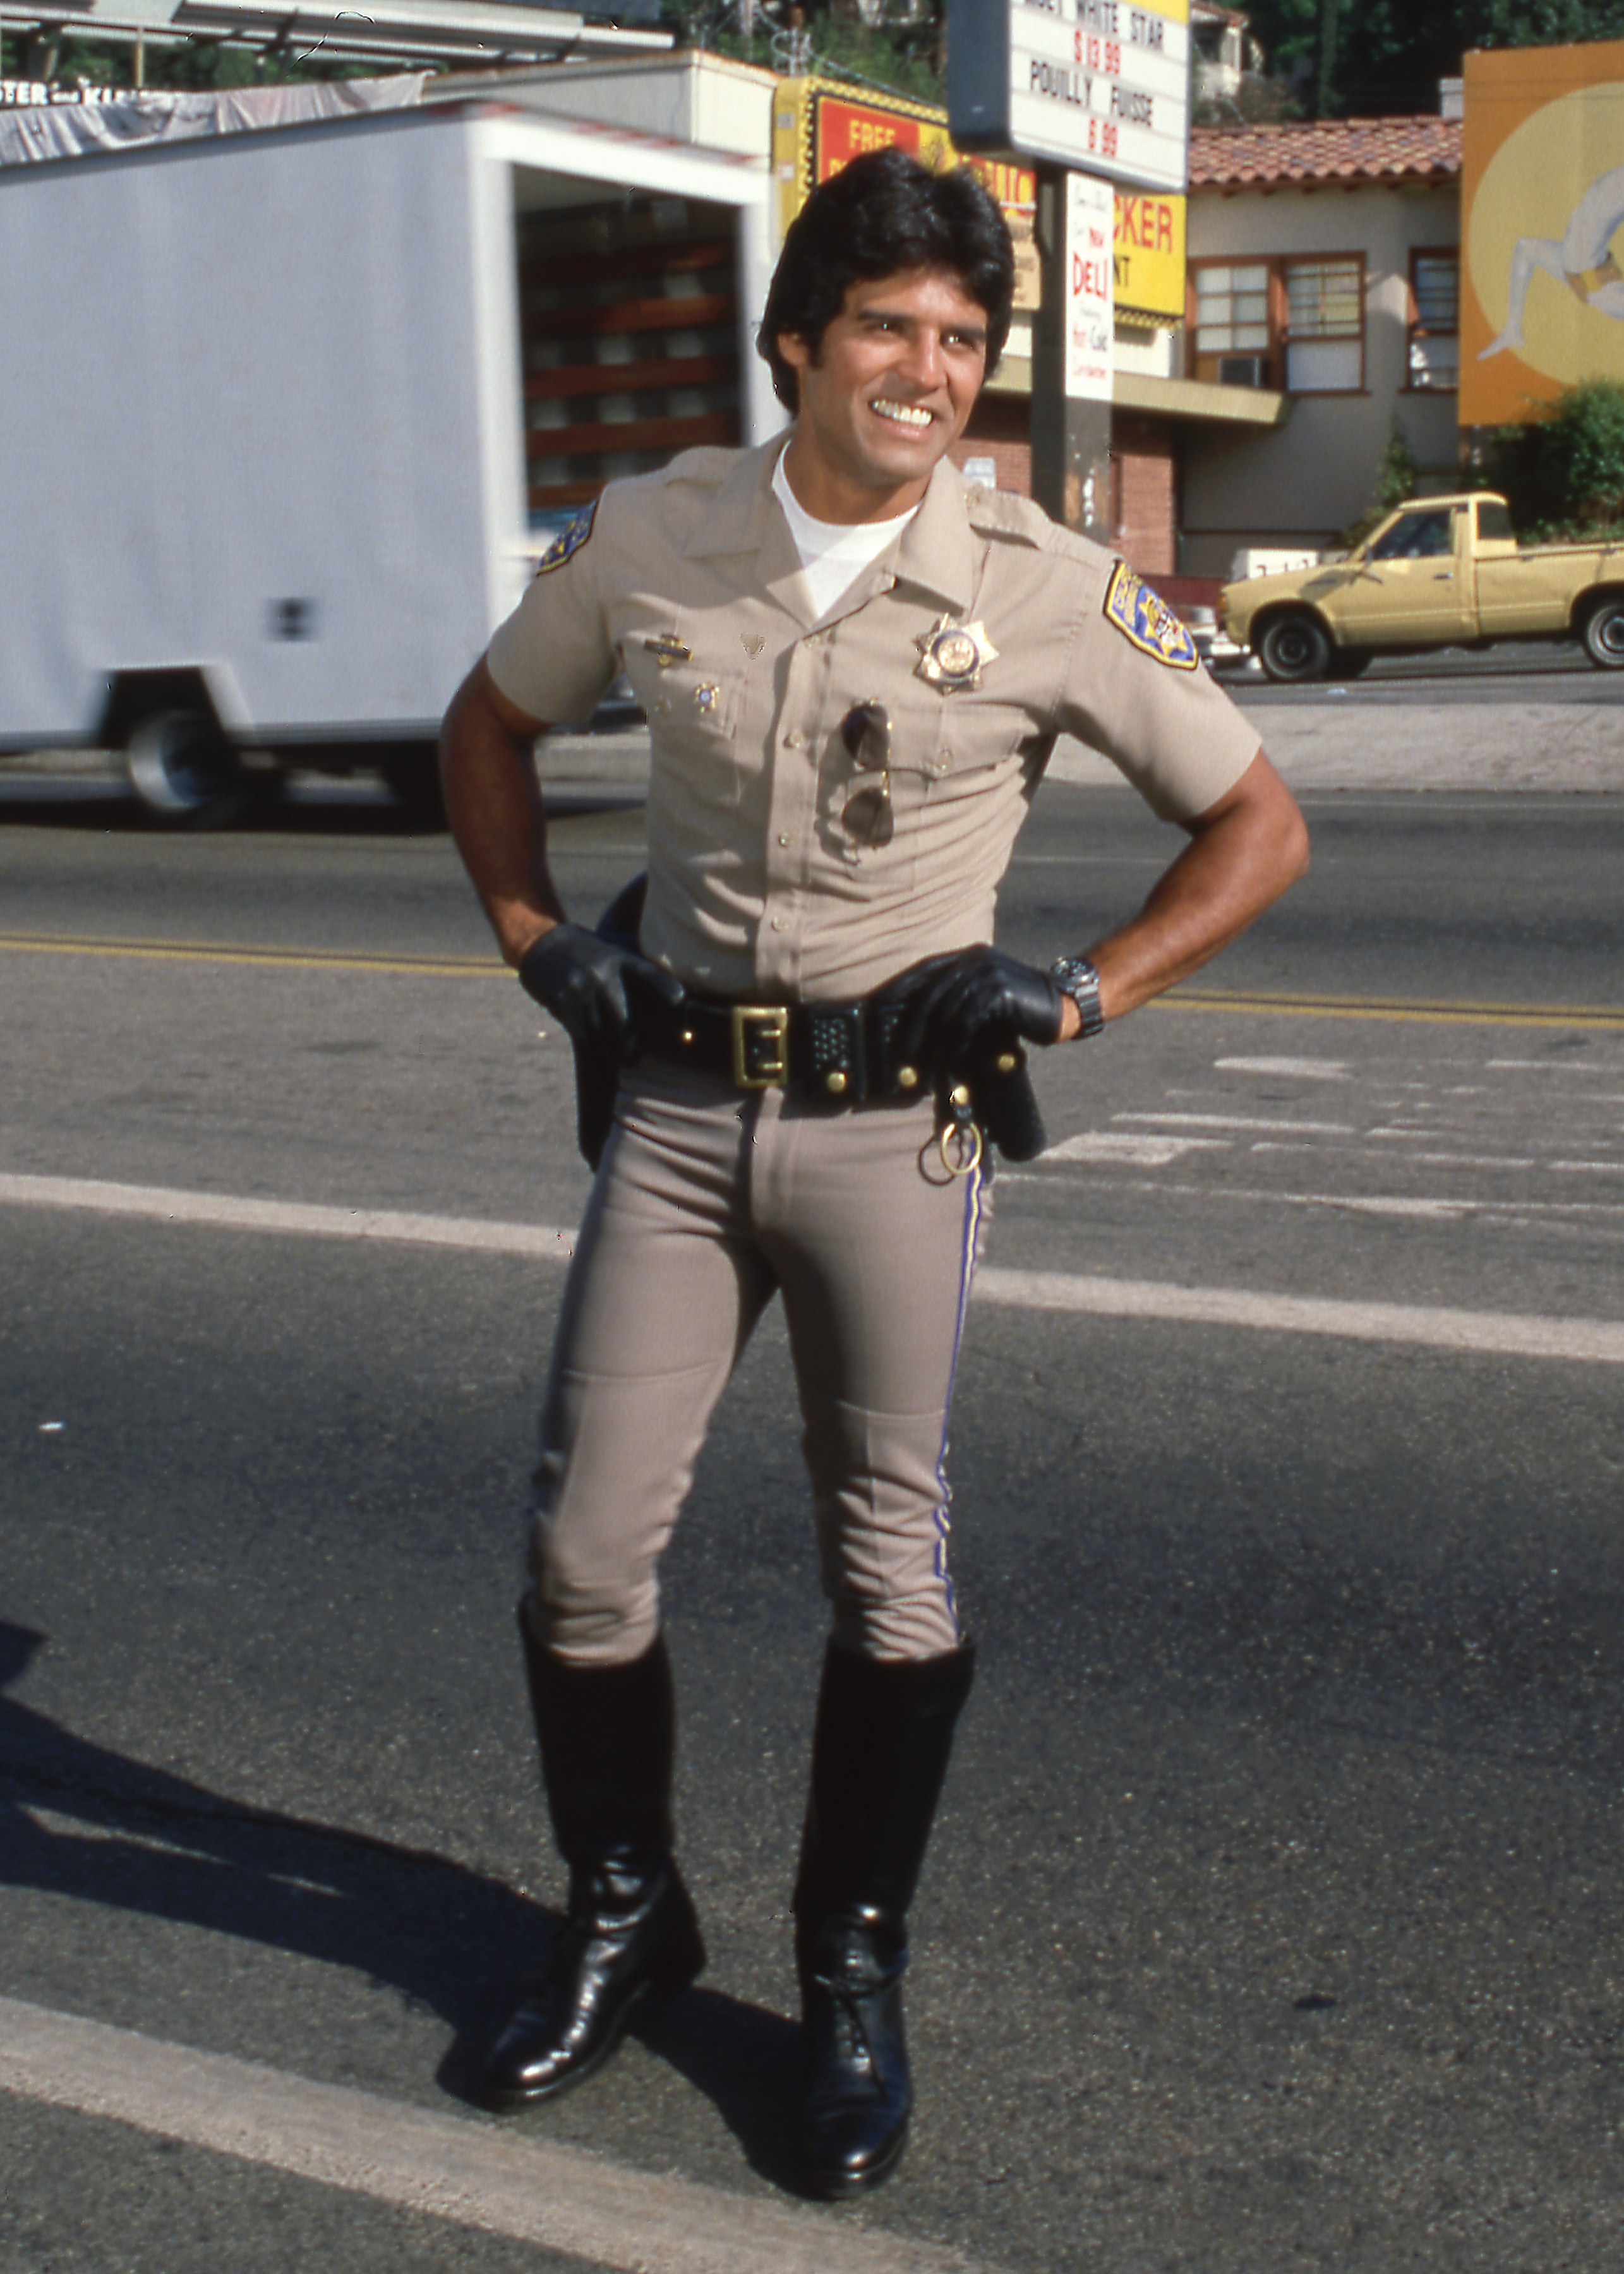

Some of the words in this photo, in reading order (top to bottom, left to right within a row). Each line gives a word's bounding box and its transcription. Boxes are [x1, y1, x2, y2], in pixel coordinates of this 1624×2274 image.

[1131, 11, 1164, 52] STAR
[0, 77, 48, 106] TER
[1030, 59, 1093, 107] POUILLY
[849, 118, 896, 152] FREE
[1073, 251, 1107, 302] DELI
